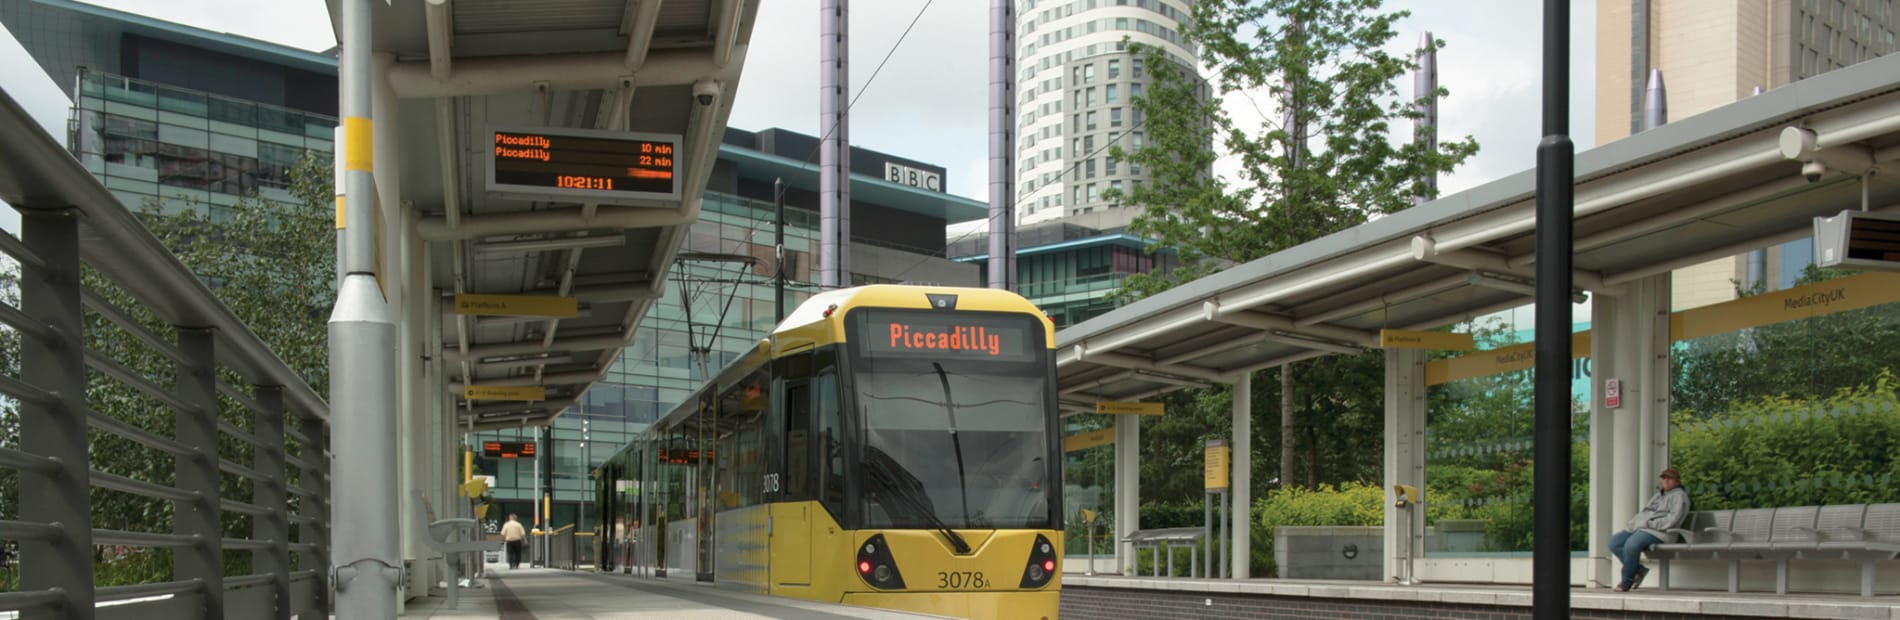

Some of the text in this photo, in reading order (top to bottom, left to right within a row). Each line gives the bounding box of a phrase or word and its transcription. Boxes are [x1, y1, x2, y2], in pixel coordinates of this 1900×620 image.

[495, 134, 672, 154] Piccadilly 10 min
[495, 147, 672, 166] Piccadilly 22 min
[557, 175, 613, 190] 10:21:11
[890, 166, 938, 192] BBC
[1783, 287, 1846, 311] MediaCityUK
[889, 322, 1000, 355] Piccadilly
[763, 472, 780, 494] 3078
